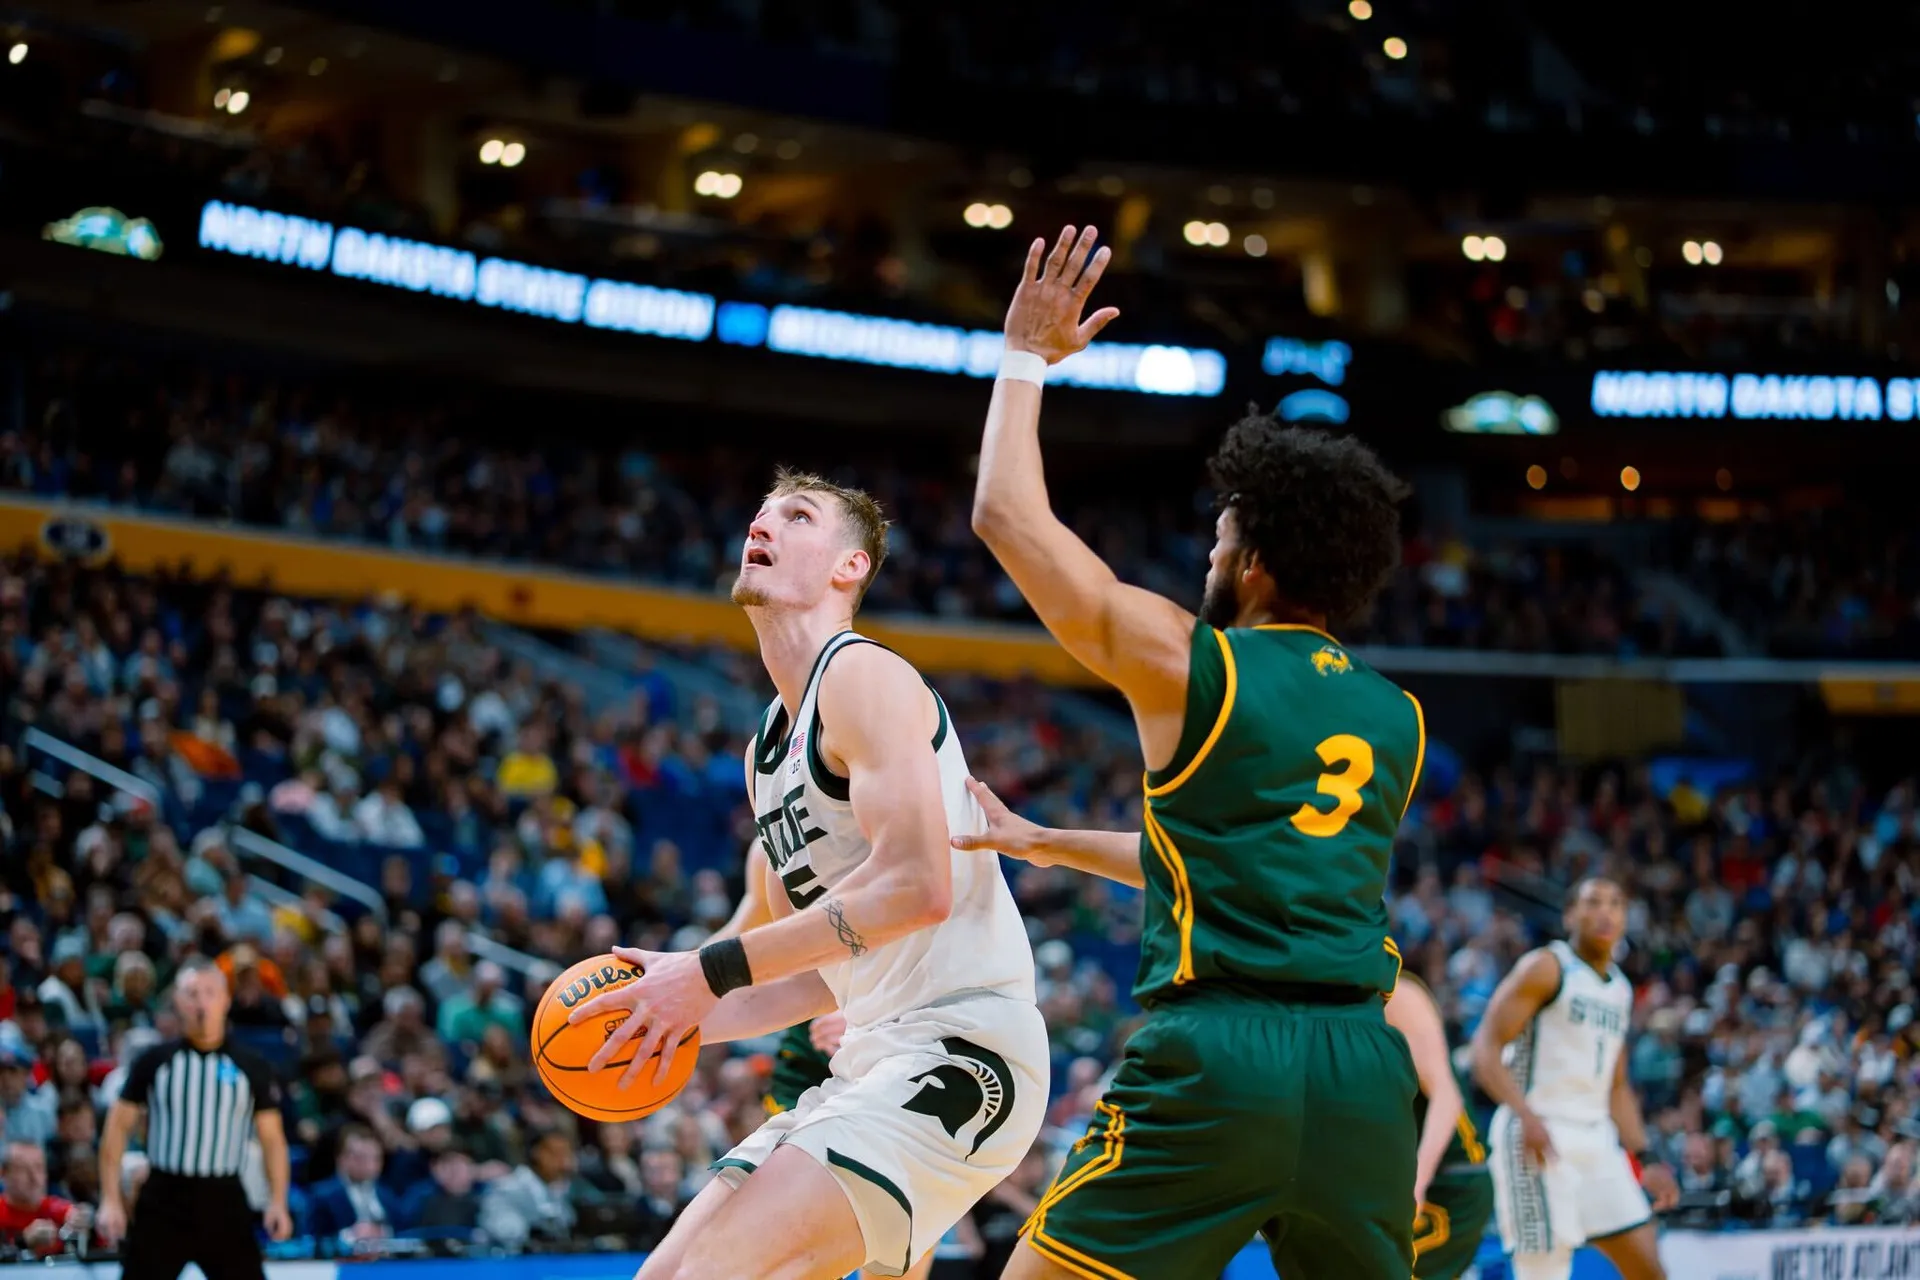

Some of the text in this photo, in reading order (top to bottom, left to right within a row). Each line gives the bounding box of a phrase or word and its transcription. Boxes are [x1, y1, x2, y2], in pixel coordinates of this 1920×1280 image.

[199, 200, 333, 271] NORTH
[332, 227, 476, 301] DAKOTA
[1591, 370, 1729, 418] NORTH
[1731, 373, 1883, 420] DAKOTA
[1289, 733, 1375, 837] 3
[557, 965, 646, 1007] Wilso
